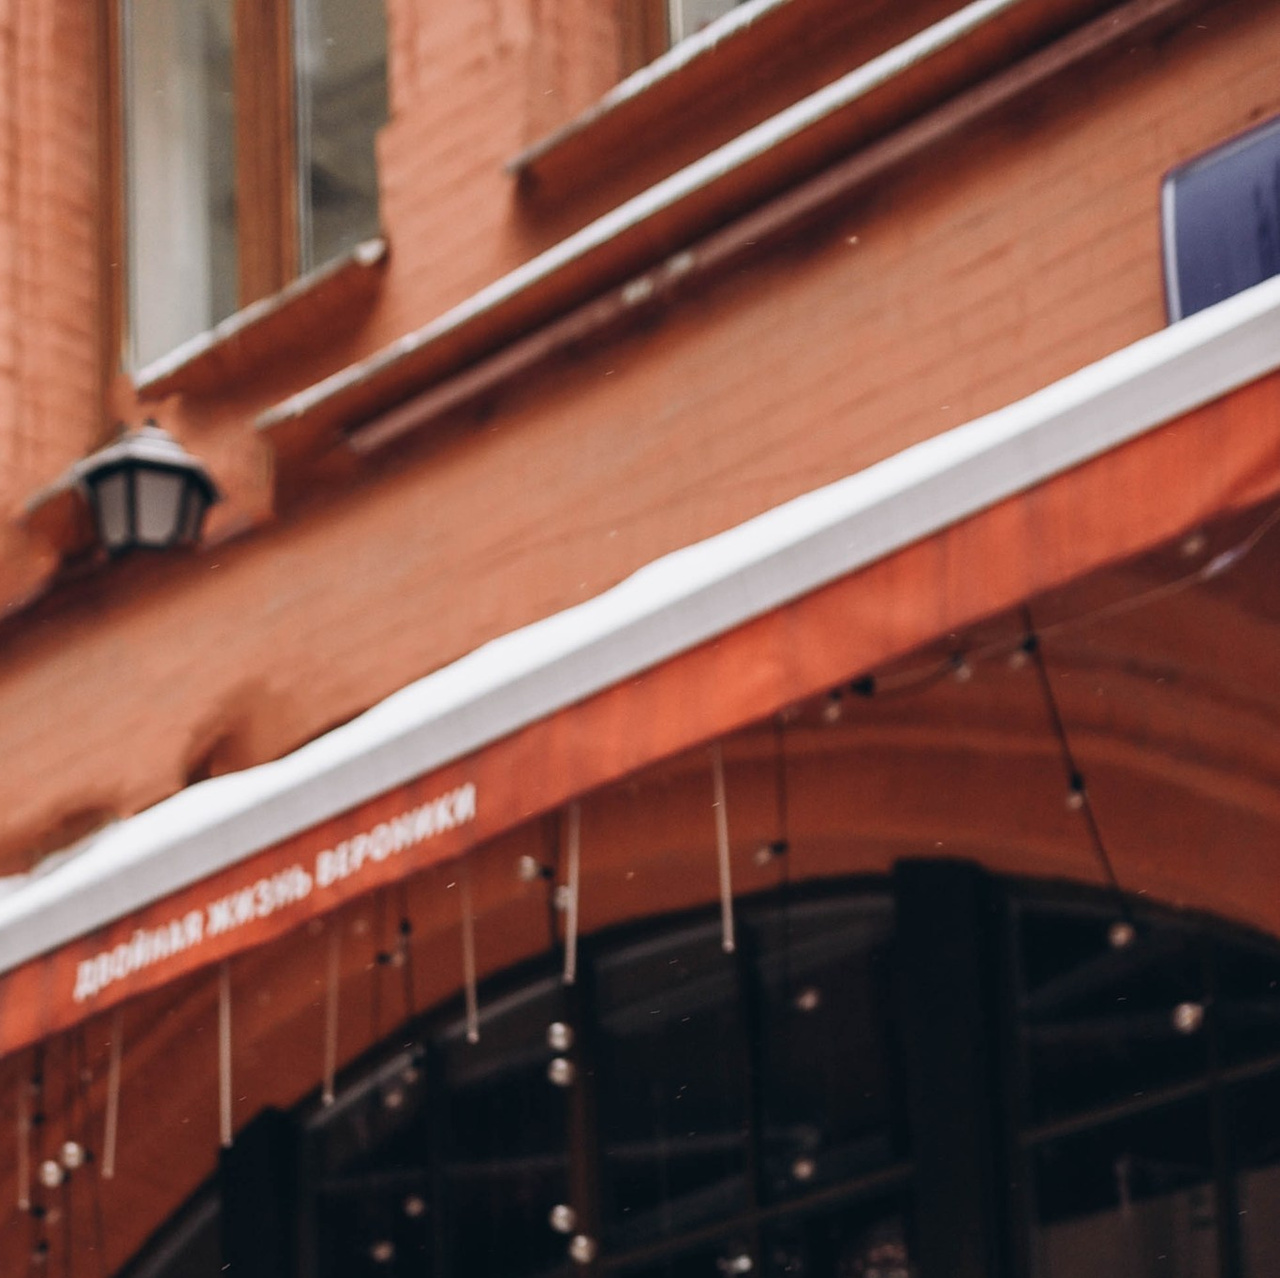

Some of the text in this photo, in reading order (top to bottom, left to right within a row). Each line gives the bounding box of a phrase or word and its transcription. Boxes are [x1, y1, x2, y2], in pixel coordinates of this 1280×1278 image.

[73, 783, 477, 1002] ДВОЙНАЯ ЖИЗНЬ ВЕРОНИКИ
